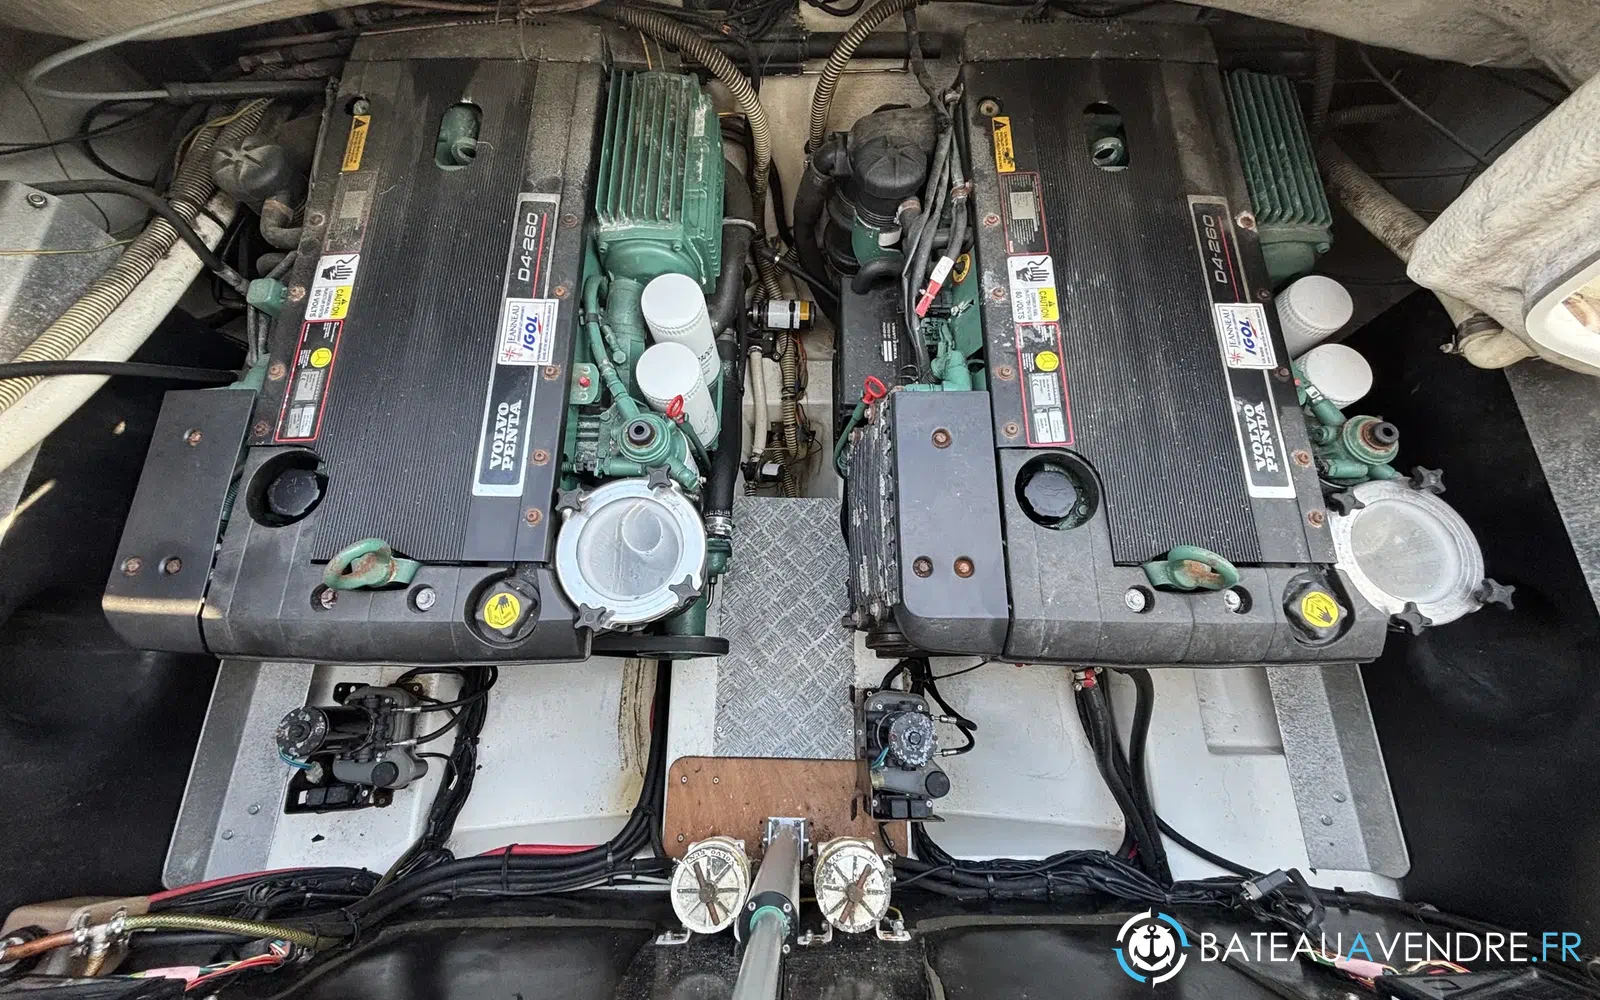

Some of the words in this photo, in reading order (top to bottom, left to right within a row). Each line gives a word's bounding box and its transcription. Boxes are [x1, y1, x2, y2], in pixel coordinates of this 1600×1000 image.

[517, 212, 539, 282] D4-260
[1202, 214, 1228, 284] D4-260
[310, 298, 320, 318] VOLTS
[330, 289, 344, 316] CAUTION
[507, 305, 520, 344] JEANNEAU
[1016, 300, 1025, 320] VOLTS
[1039, 291, 1051, 318] CAUTION
[1222, 309, 1240, 348] JEANNEAU
[489, 402, 510, 470] VOLVO
[501, 399, 522, 471] PENTA
[1243, 403, 1267, 472] VOLVO
[1254, 401, 1279, 473] PENTA
